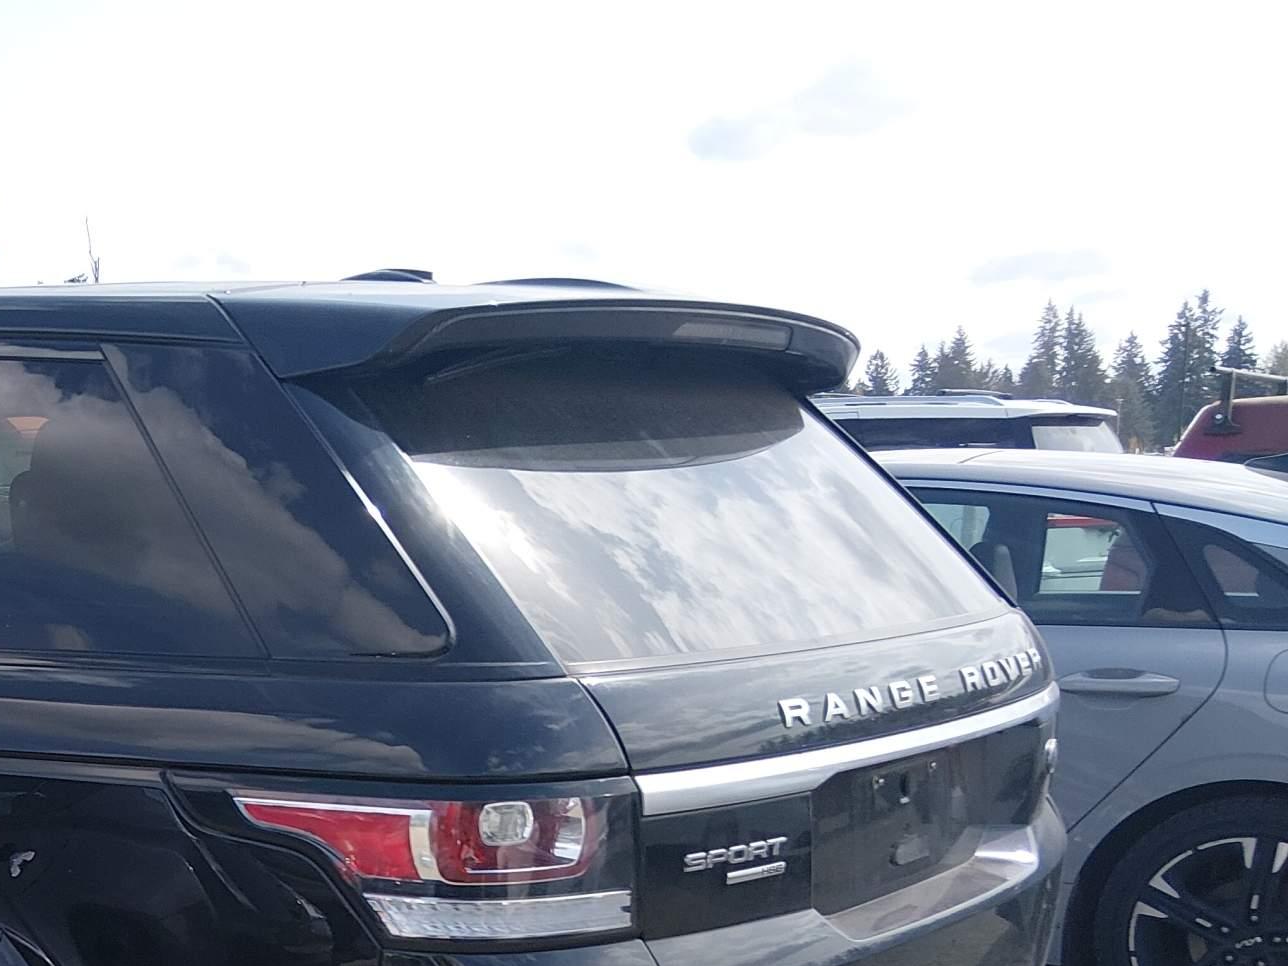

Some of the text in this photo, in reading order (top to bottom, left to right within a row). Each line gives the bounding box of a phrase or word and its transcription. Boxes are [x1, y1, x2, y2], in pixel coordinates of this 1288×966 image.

[777, 648, 1043, 728] RANGE ROVER
[683, 836, 788, 873] SPORT
